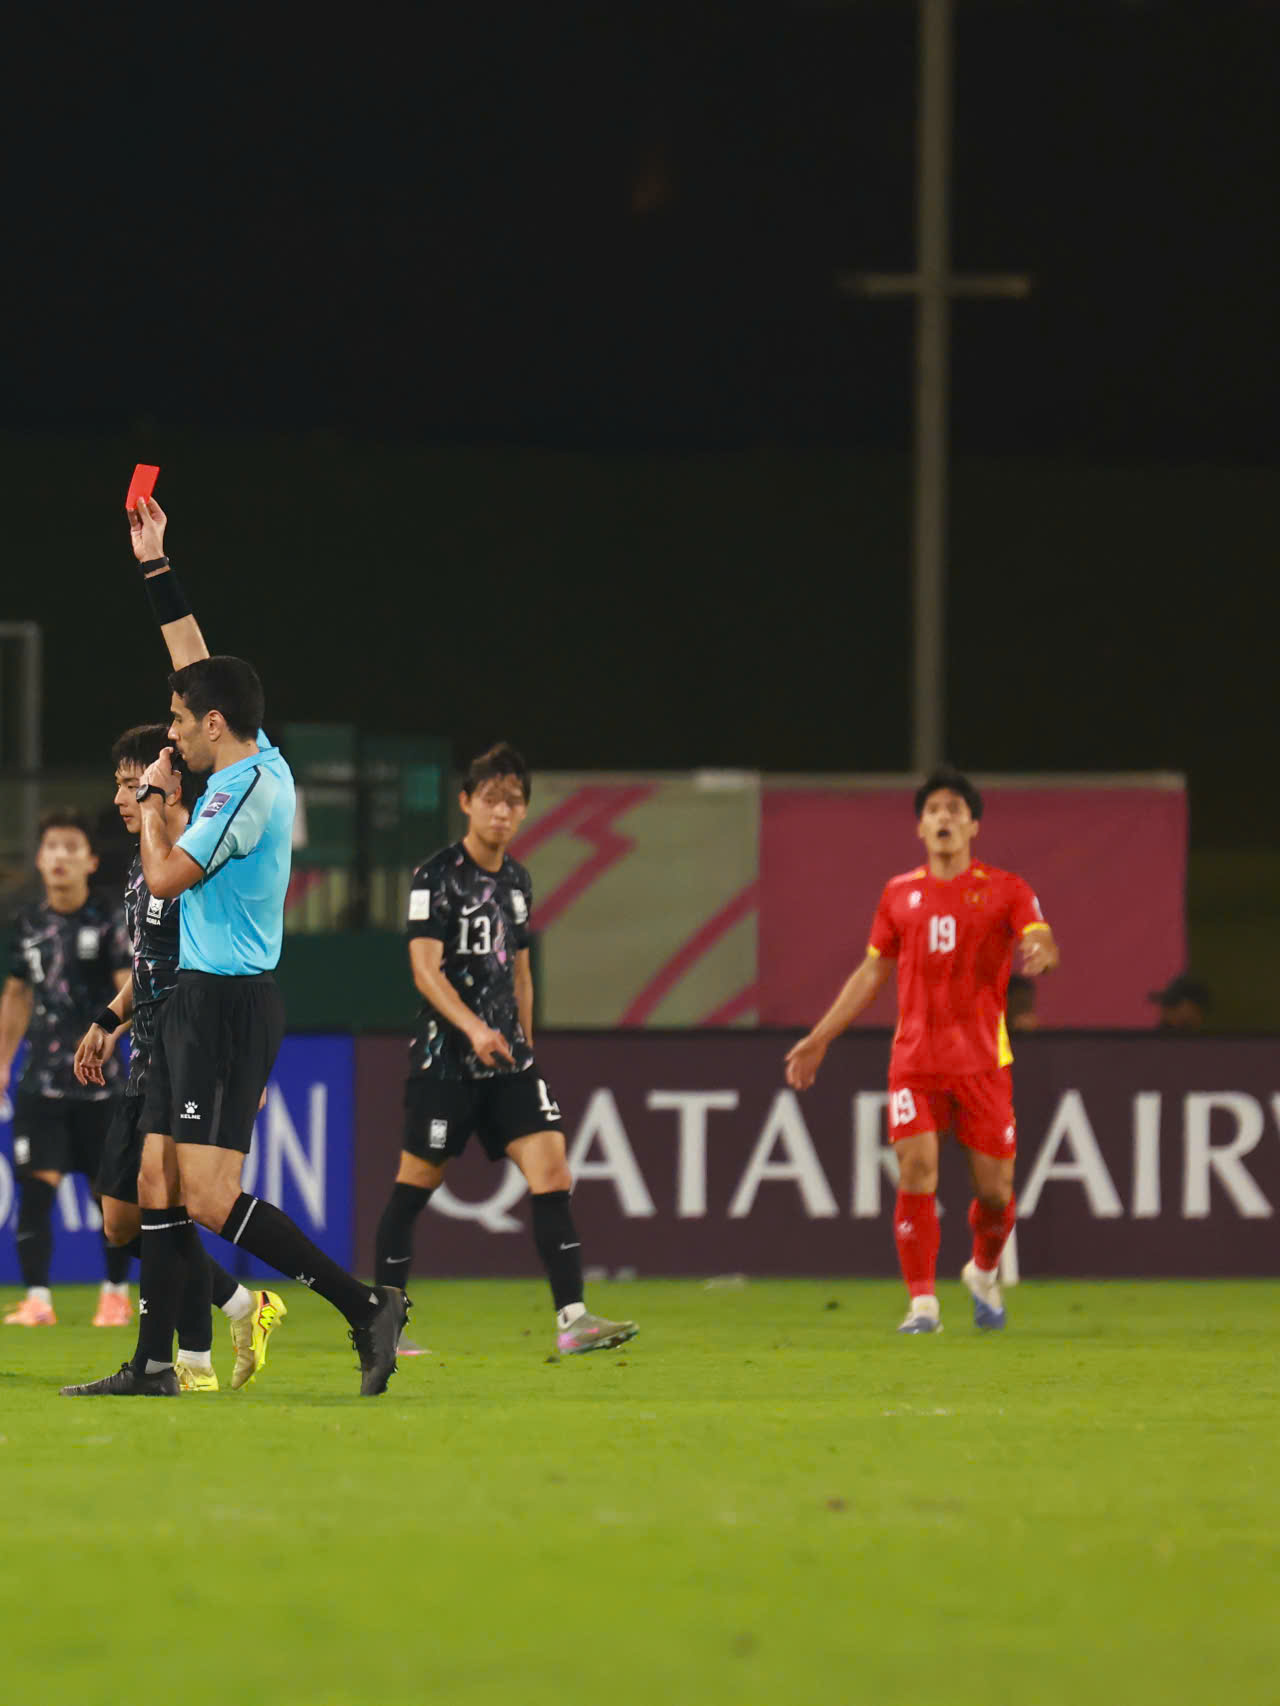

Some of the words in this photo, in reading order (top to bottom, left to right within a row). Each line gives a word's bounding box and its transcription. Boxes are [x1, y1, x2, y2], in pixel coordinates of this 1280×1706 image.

[456, 915, 492, 955] 13
[928, 913, 957, 954] 19
[891, 1087, 917, 1127] 19
[1016, 1087, 1280, 1220] AIR
